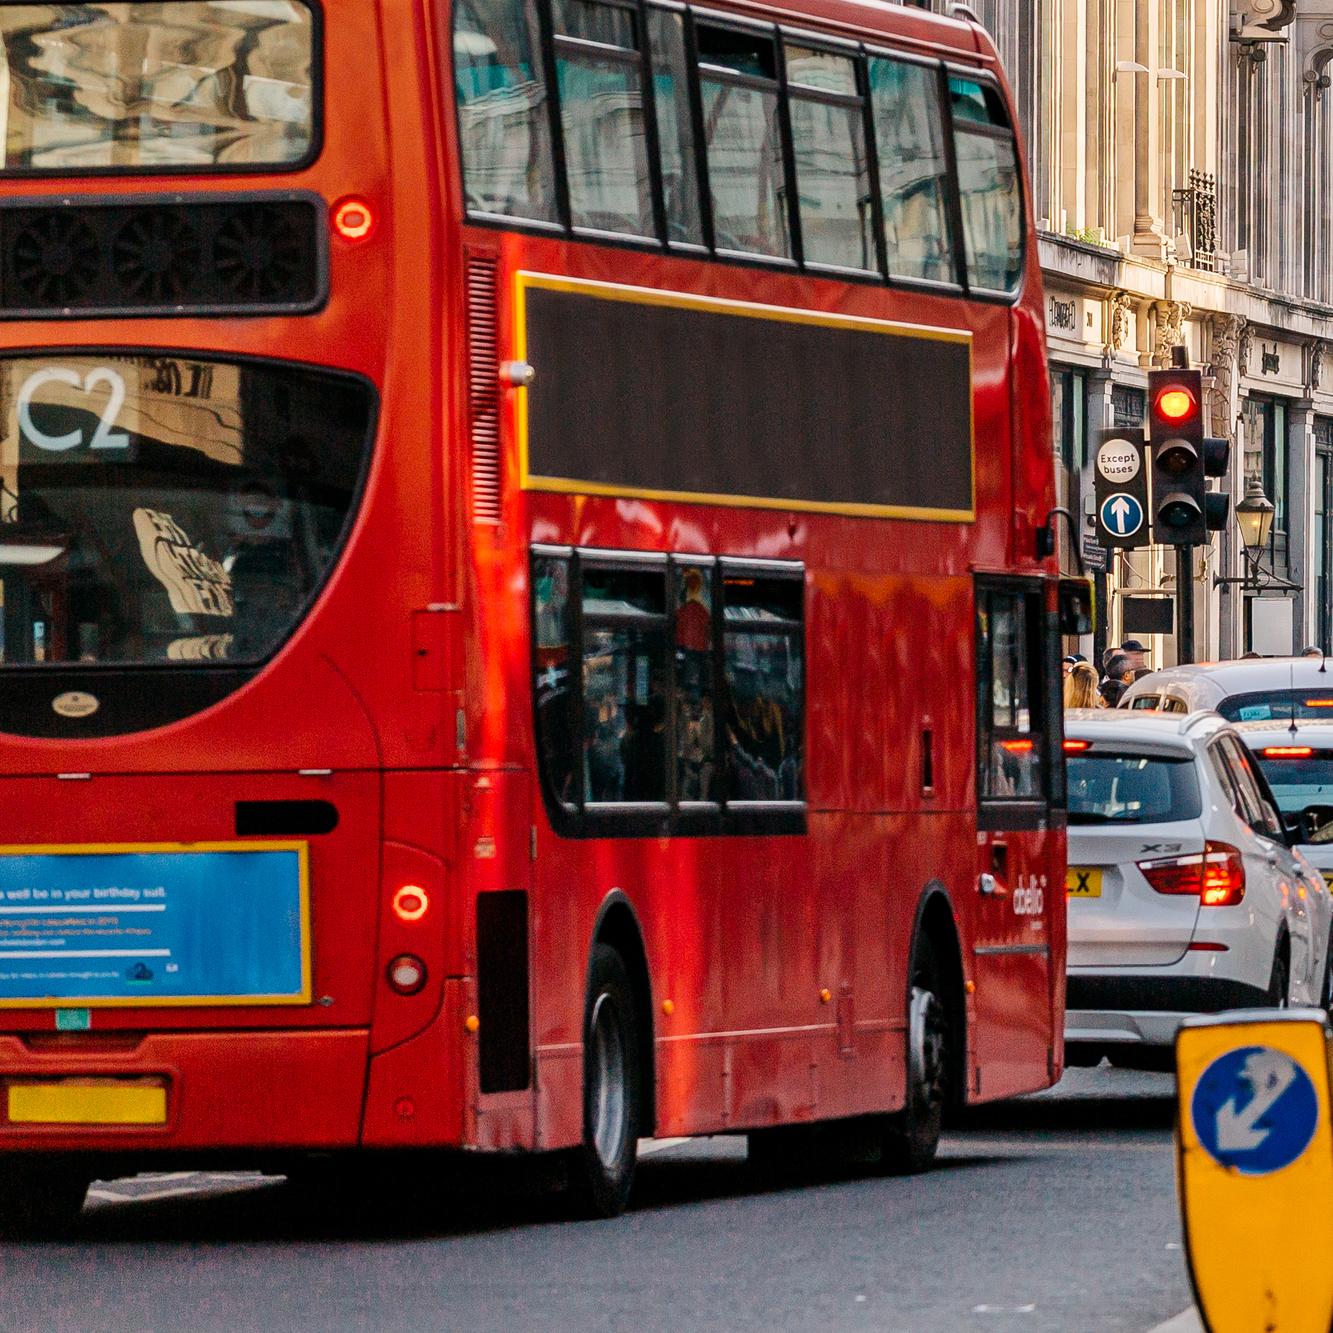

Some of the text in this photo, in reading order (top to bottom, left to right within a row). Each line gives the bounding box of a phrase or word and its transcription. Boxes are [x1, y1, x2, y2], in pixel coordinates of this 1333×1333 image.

[17, 367, 129, 451] C2
[1101, 453, 1135, 464] Except
[1104, 465, 1133, 474] buses
